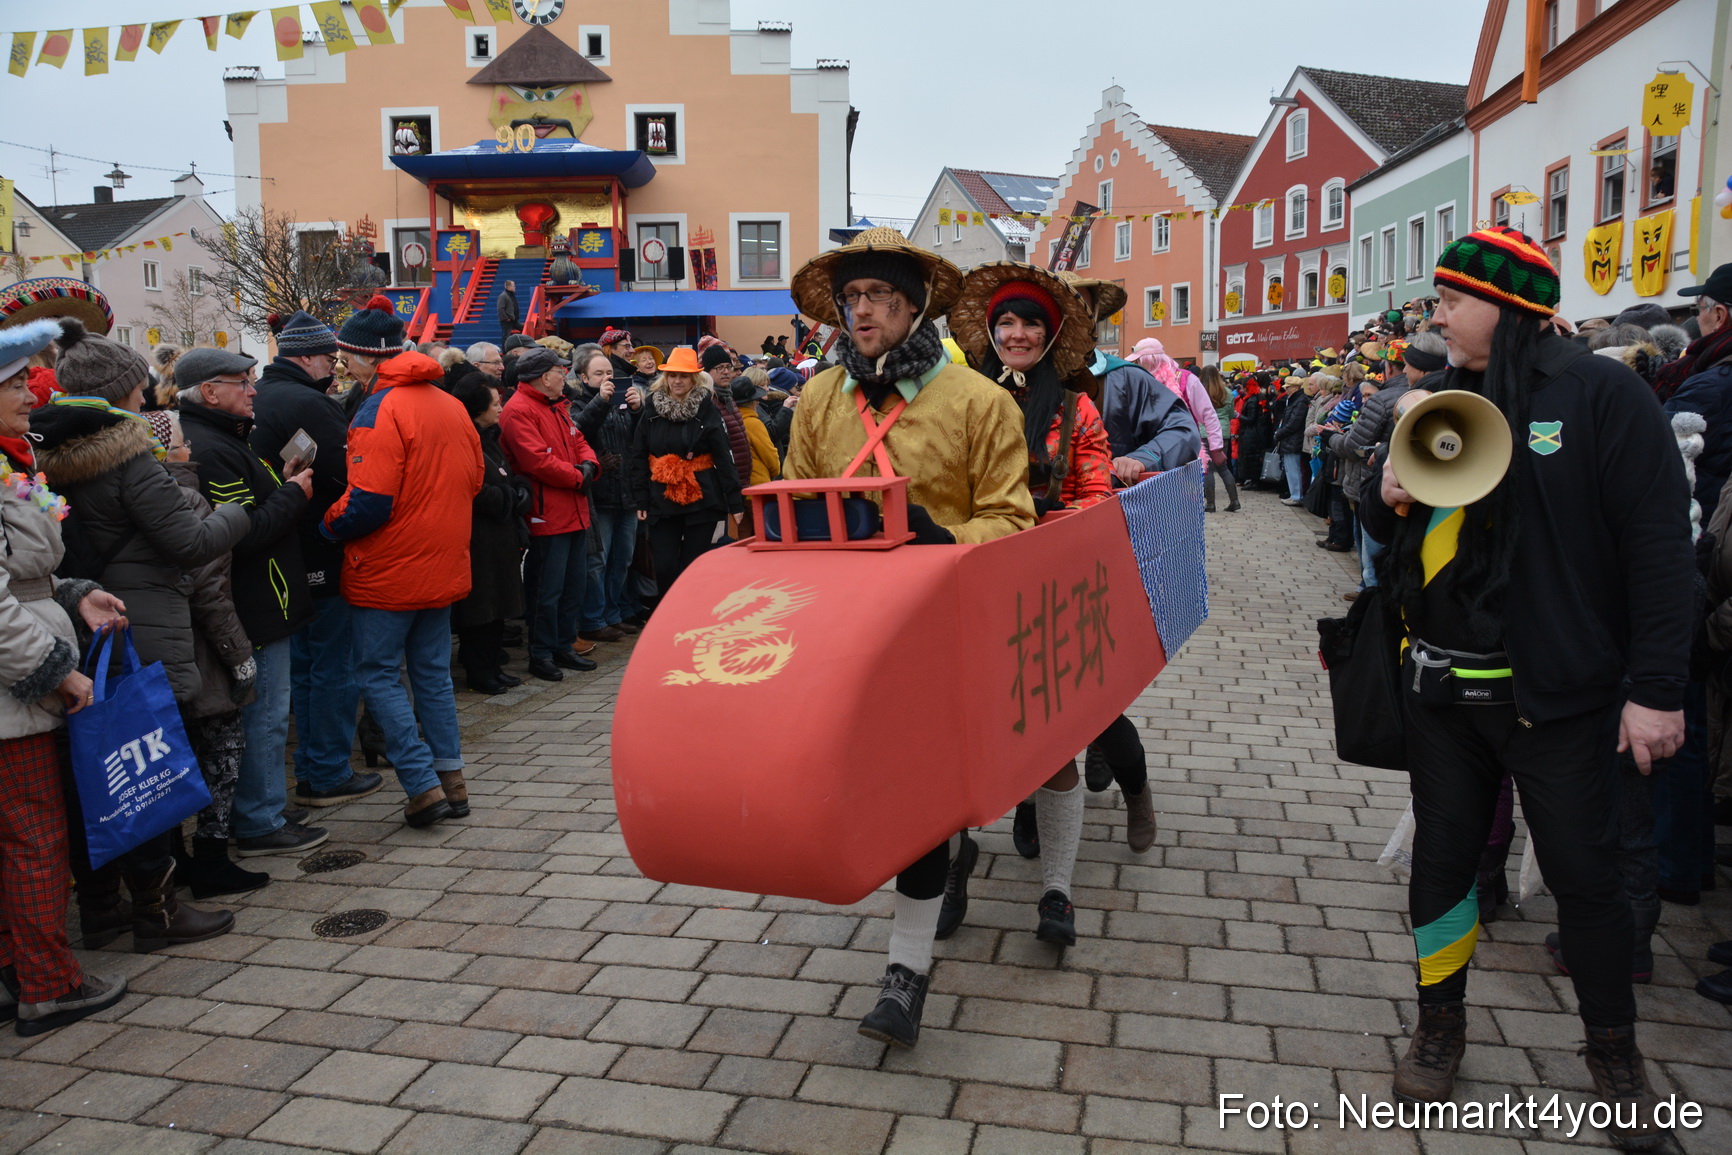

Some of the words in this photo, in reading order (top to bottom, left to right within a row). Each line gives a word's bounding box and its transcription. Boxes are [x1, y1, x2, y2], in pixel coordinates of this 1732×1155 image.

[495, 123, 535, 152] 90
[1201, 331, 1216, 341] CAFÉ
[1007, 560, 1115, 736] 排球
[118, 785, 137, 804] JOSEF
[138, 775, 160, 791] KLIER
[159, 768, 172, 780] KG
[134, 790, 152, 803] Lyren
